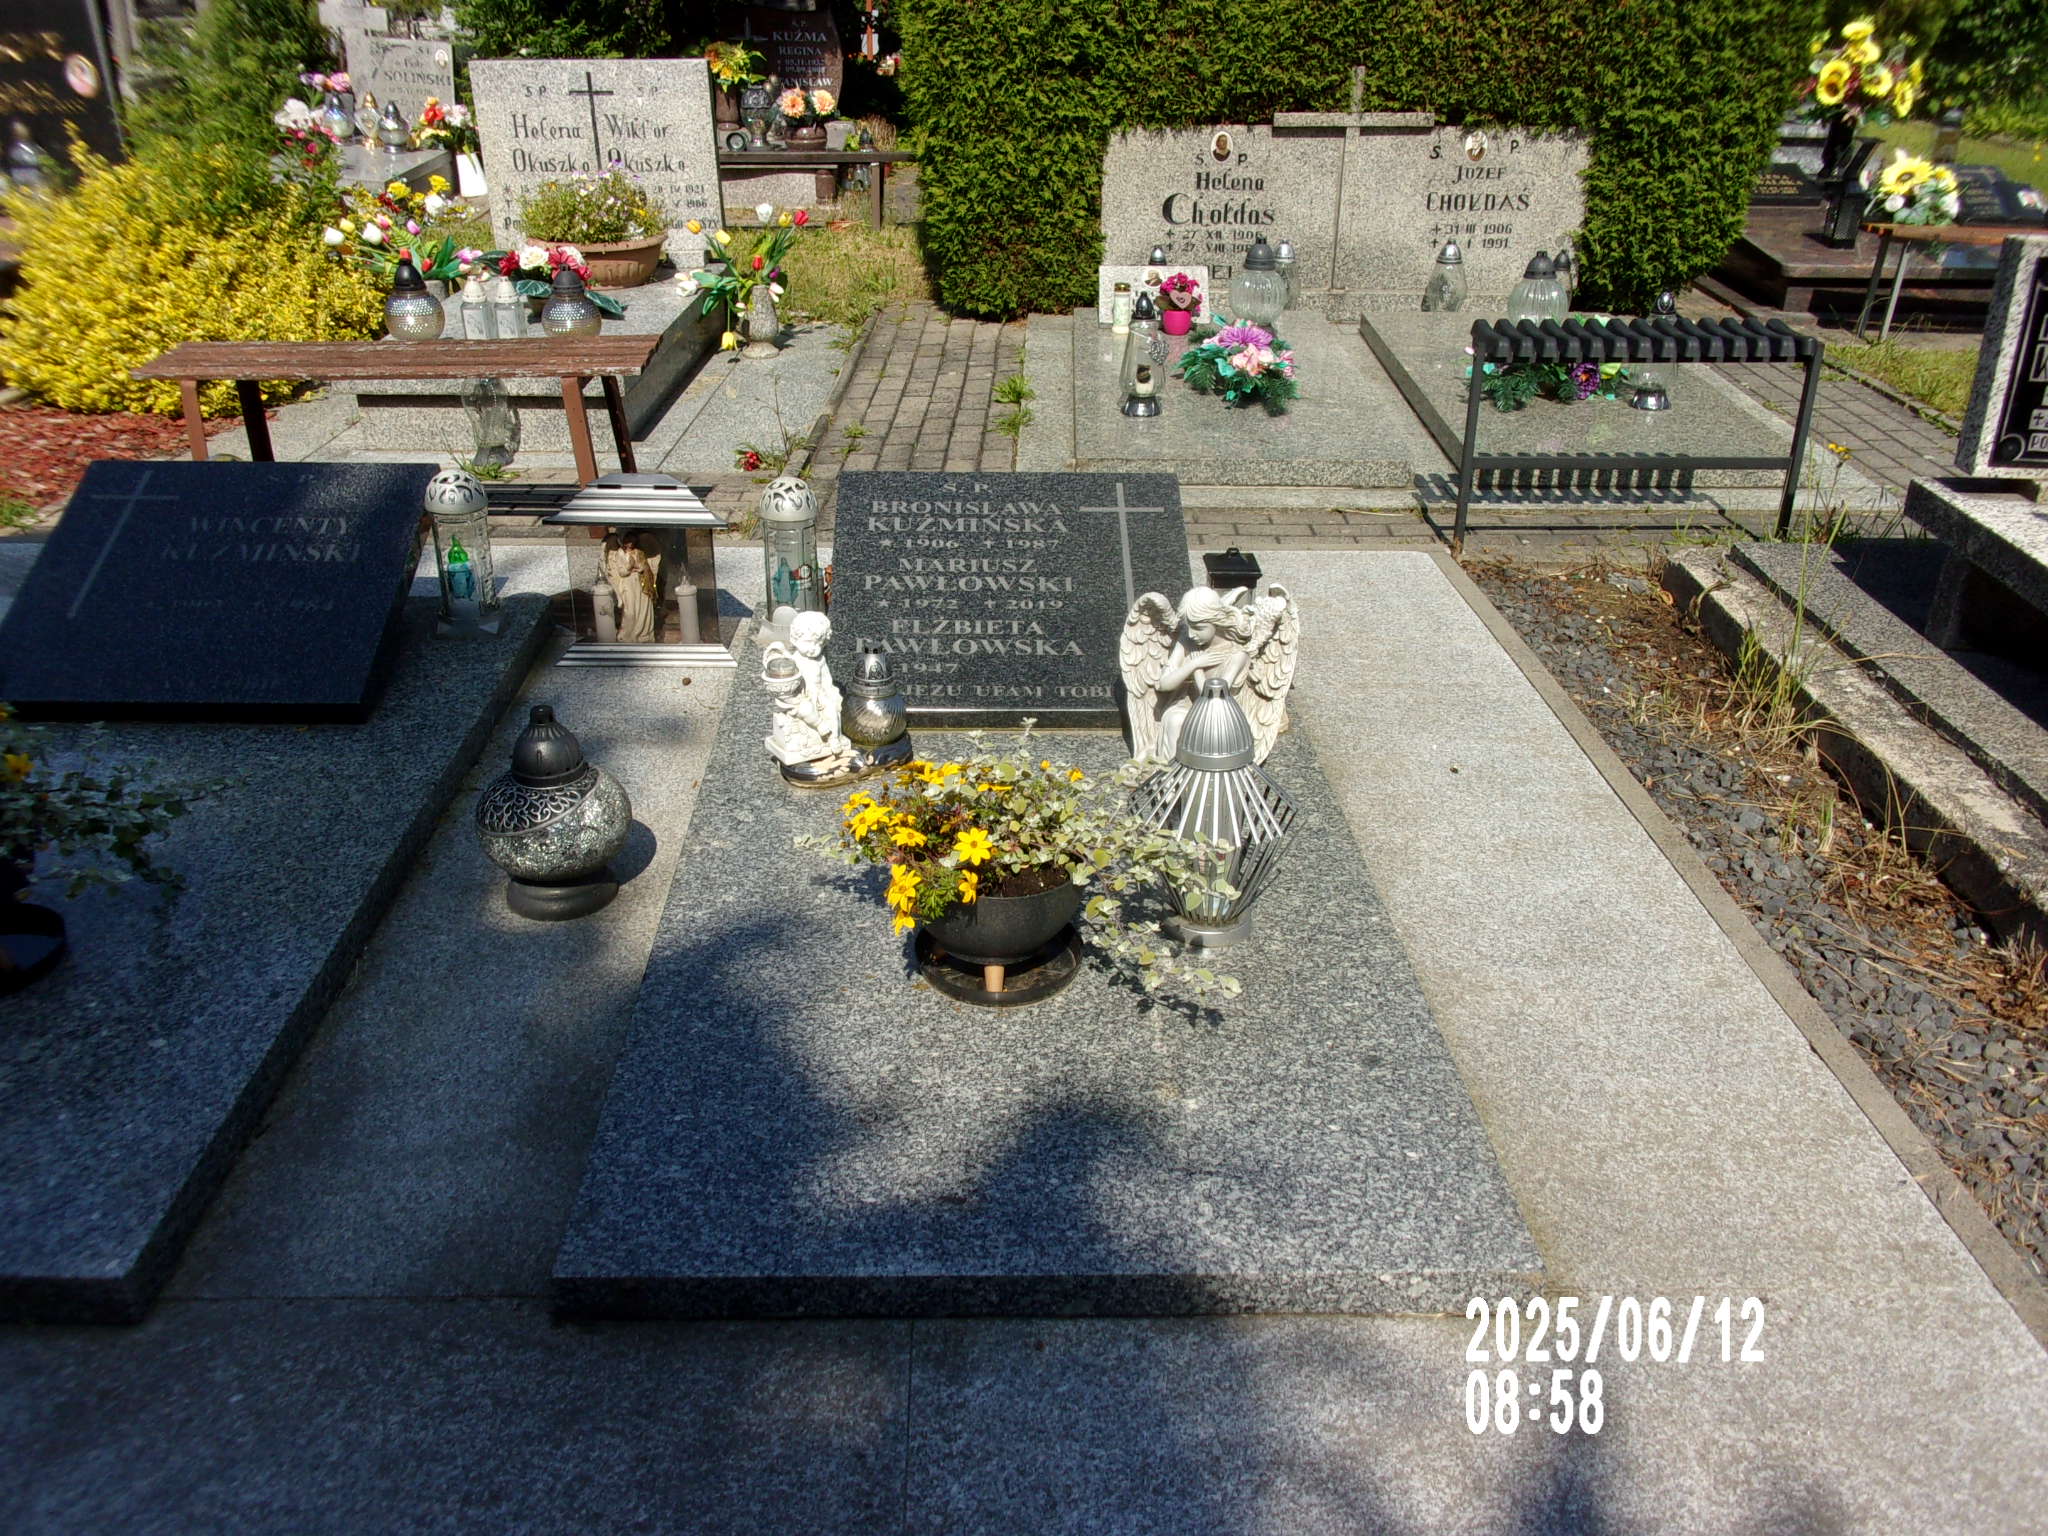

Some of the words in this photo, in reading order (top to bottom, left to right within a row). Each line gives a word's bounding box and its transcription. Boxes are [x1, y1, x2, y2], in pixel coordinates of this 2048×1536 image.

[511, 113, 582, 140] Helena
[603, 113, 672, 139] Wiktor
[512, 148, 590, 173] Okuszko
[607, 147, 686, 173] Okuszko
[1195, 167, 1265, 191] Helena
[867, 512, 1070, 533] KUŹMIŃSKA
[904, 538, 960, 549] 1906
[1006, 538, 1060, 549] 1987
[899, 557, 1038, 573] MARIUSZ
[863, 575, 1074, 593] PAWŁOWSKI
[903, 599, 960, 610] 1972
[1006, 600, 1064, 610] 2019
[891, 617, 1048, 636] ELŻBIETA
[855, 637, 1087, 656] PAWŁOWSKA
[900, 663, 959, 675] 1947
[903, 684, 962, 697] JEZU
[972, 684, 1042, 698] UFAM
